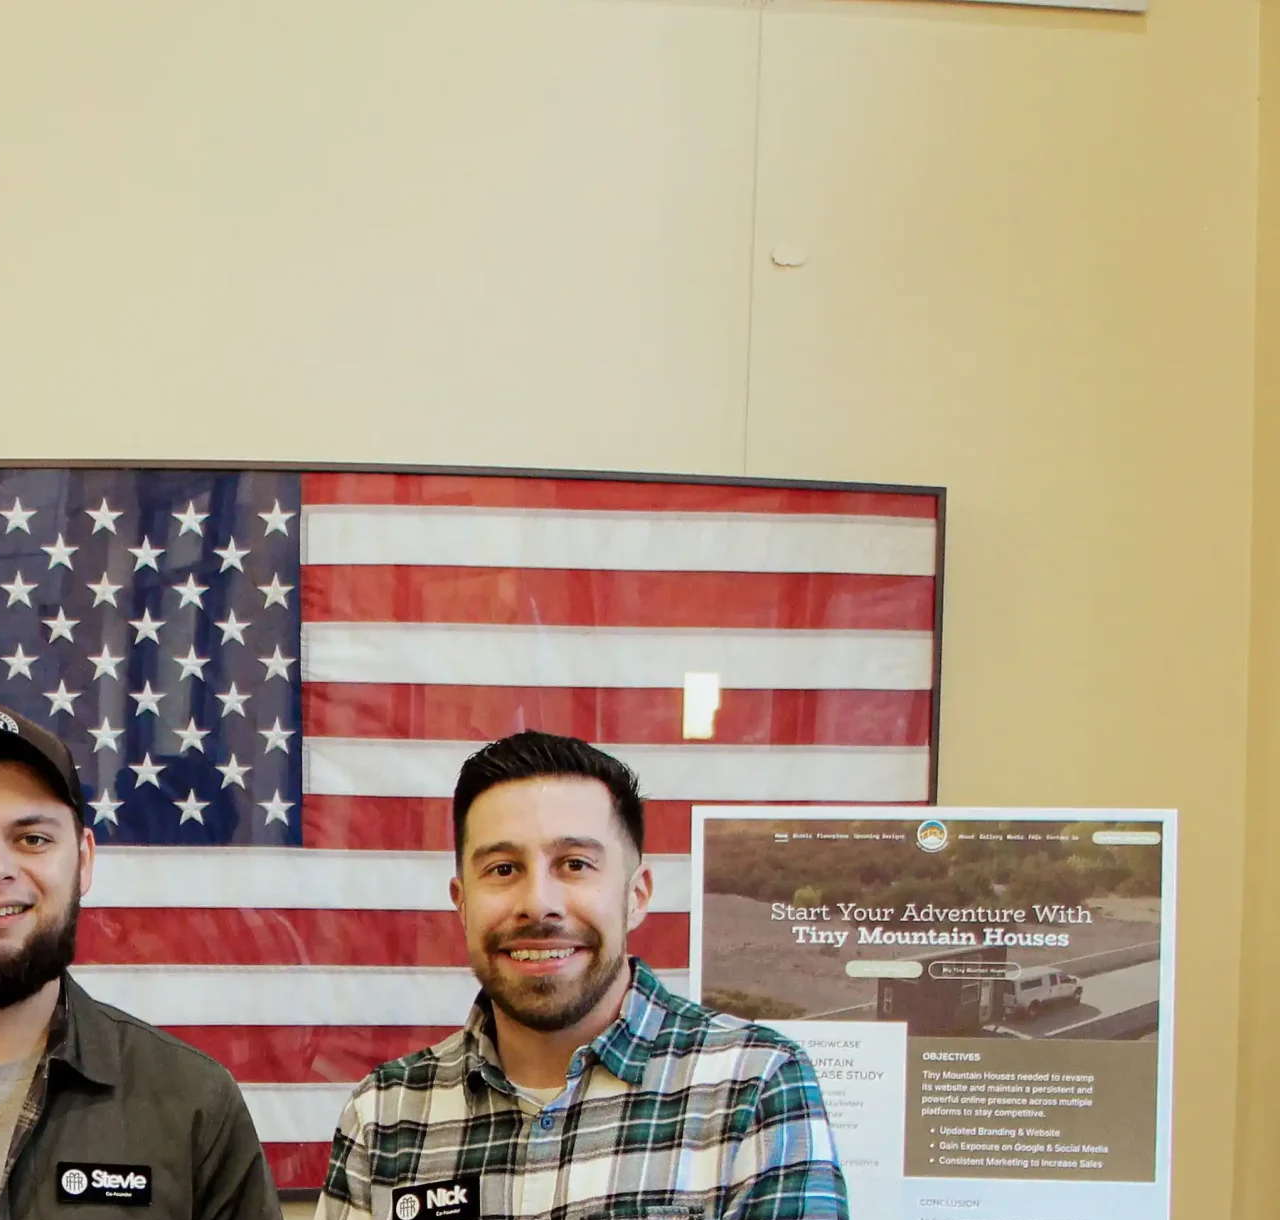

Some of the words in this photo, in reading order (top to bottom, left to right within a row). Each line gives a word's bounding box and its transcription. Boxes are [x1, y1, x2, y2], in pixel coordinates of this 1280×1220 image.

[772, 903, 830, 920] Start
[836, 903, 894, 920] Your
[900, 904, 1025, 922] Adventure
[1032, 905, 1092, 923] With
[792, 926, 848, 946] Tiny
[858, 927, 976, 946] Mountain
[983, 928, 1069, 947] Houses
[922, 1052, 980, 1060] OBJECTIVES
[940, 1126, 976, 1135] Updated
[978, 1127, 1016, 1137] Branding
[1018, 1128, 1024, 1136] &
[1026, 1128, 1060, 1136] Website
[92, 1169, 147, 1190] Stevie
[426, 1185, 468, 1210] Nick
